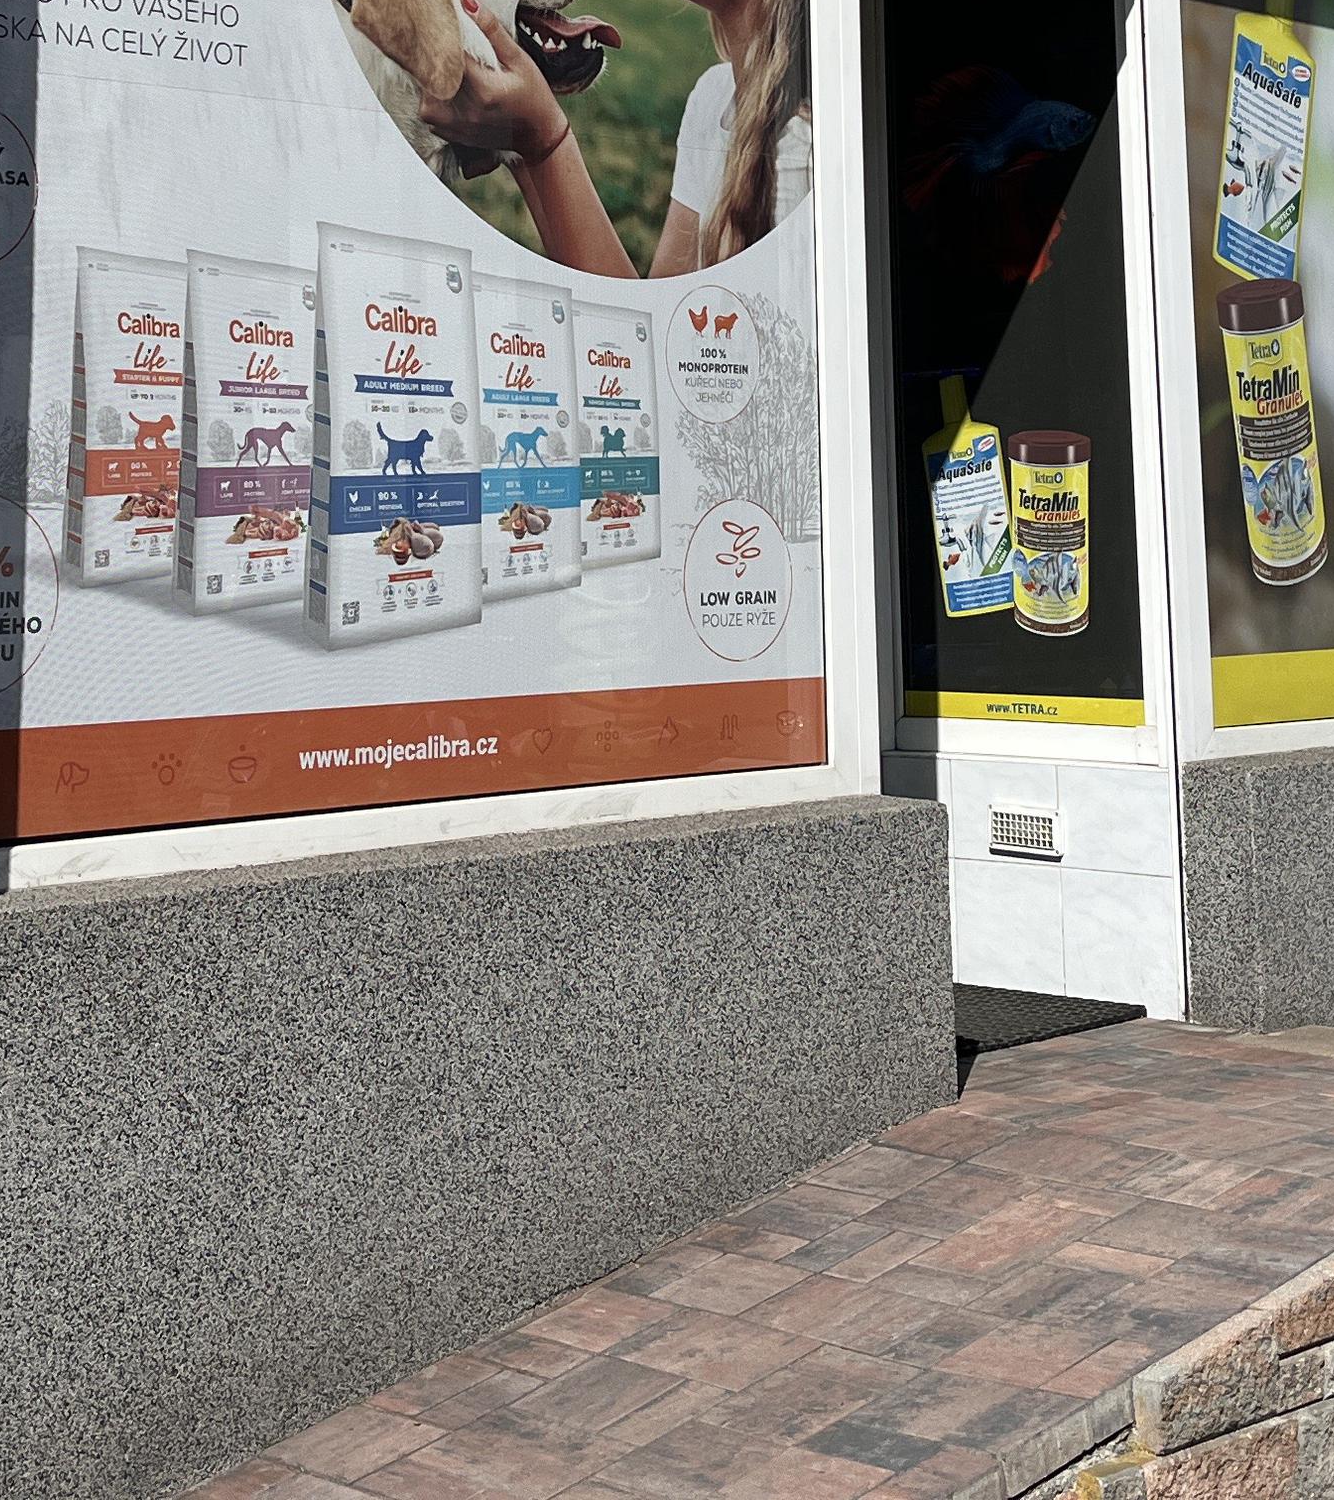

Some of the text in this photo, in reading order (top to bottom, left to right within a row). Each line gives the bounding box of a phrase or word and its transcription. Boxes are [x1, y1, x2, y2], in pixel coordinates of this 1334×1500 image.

[56, 21, 95, 49] NA
[102, 28, 167, 57] CELÝ
[173, 30, 249, 67] ŽIVOT
[1242, 62, 1302, 109] AquaSafe
[117, 312, 181, 339] Calibra
[228, 318, 295, 348] Calibra
[365, 303, 438, 337] Calibra
[133, 341, 168, 371] Life
[490, 332, 546, 359] Calibra
[587, 349, 632, 369] Calibra
[245, 351, 281, 384] Life
[384, 340, 424, 379] Life
[678, 361, 749, 375] MONOPROTEIN
[363, 380, 388, 390] ADULT
[505, 361, 535, 392] Life
[598, 374, 624, 398] Life
[717, 378, 743, 390] NEBO
[1235, 365, 1300, 402] TetraMin
[1256, 390, 1304, 416] Granules
[938, 460, 993, 483] AquaSafe
[1018, 487, 1079, 512] TetraMin
[1035, 508, 1081, 522] Granules
[700, 590, 777, 606] LOW GRAIN
[702, 613, 743, 628] POUZE
[298, 734, 499, 770] www.mojecalibra.cz
